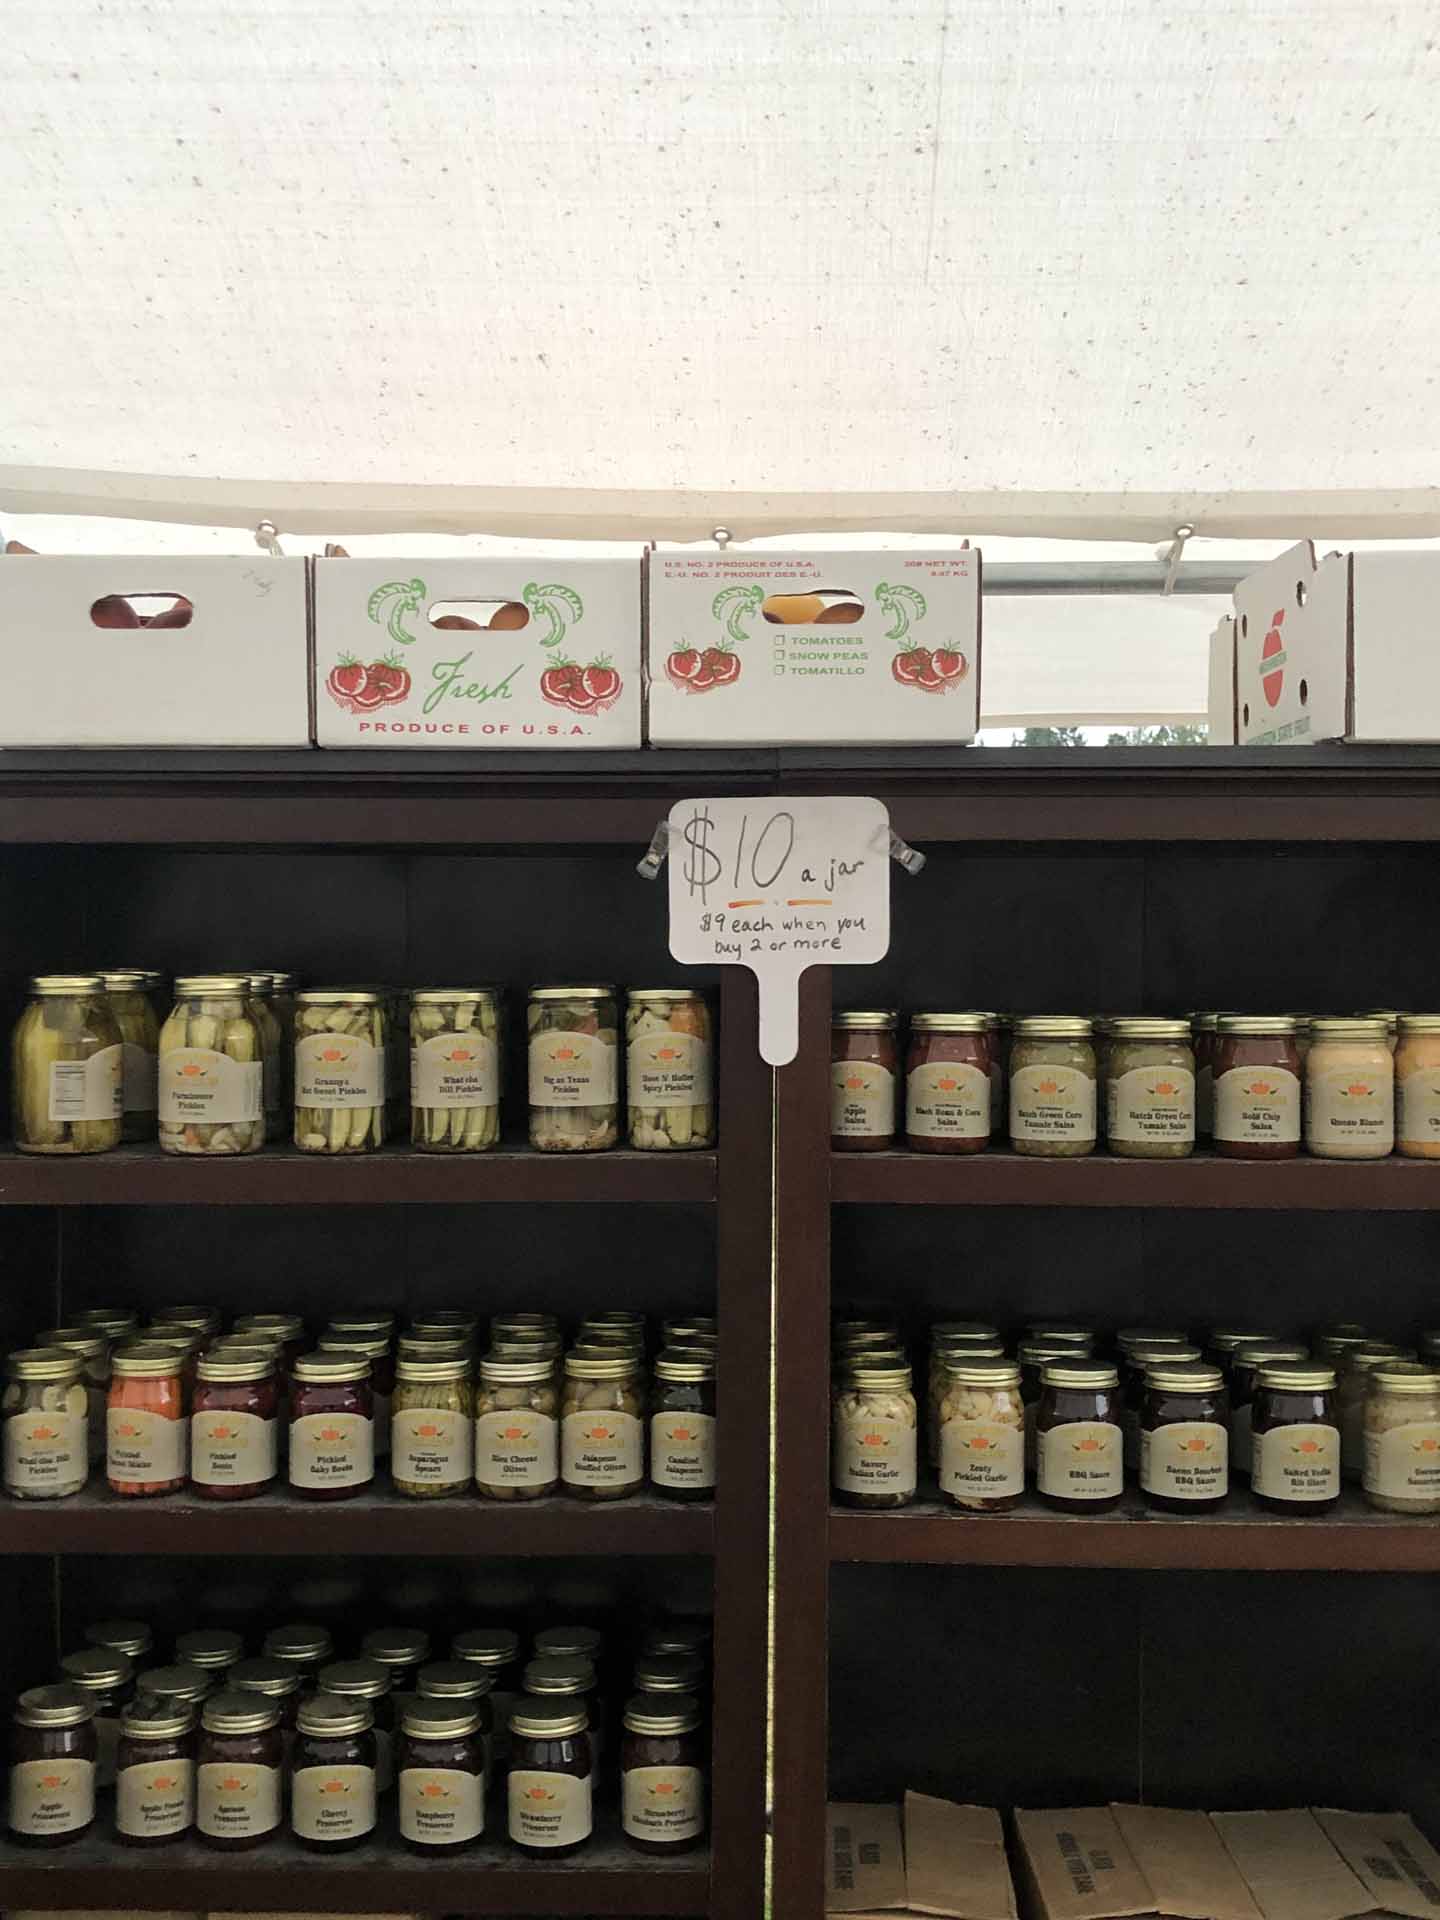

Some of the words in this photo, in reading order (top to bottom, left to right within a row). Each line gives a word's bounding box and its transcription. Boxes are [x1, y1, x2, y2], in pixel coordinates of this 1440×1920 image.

[791, 637, 864, 645] TOMATOES
[789, 652, 830, 660] SNOW
[832, 652, 869, 660] PEAS
[791, 667, 865, 675] TOMATILLO
[422, 651, 525, 714] Fresh
[359, 722, 469, 734] PRODUCE
[482, 723, 509, 735] OF
[522, 723, 592, 735] U.S.A.
[683, 805, 795, 906] $10
[801, 868, 816, 883] a
[824, 858, 865, 892] jar
[700, 912, 726, 932] $9
[731, 916, 775, 933] each
[782, 915, 827, 931] when
[837, 917, 867, 935] you
[714, 939, 742, 961] buy
[751, 938, 762, 951] 2
[769, 941, 786, 951] or
[793, 936, 842, 951] more
[455, 1085, 483, 1093] Pickles
[552, 1085, 580, 1093] Pickles
[664, 1082, 694, 1091] Pickles
[339, 1087, 368, 1096] Pickles
[1039, 1111, 1064, 1119] Green
[1129, 1112, 1153, 1120] Hatch
[1154, 1112, 1178, 1120] Green
[937, 1118, 959, 1127] Salsa
[1053, 1121, 1076, 1129] Salsa
[1250, 1121, 1273, 1130] Salsa
[317, 1455, 347, 1463] Pickled
[408, 1454, 449, 1464] Asparagus
[969, 1464, 992, 1474] Zesty
[954, 1471, 983, 1482] Pickled
[984, 1473, 1009, 1482] Garlic
